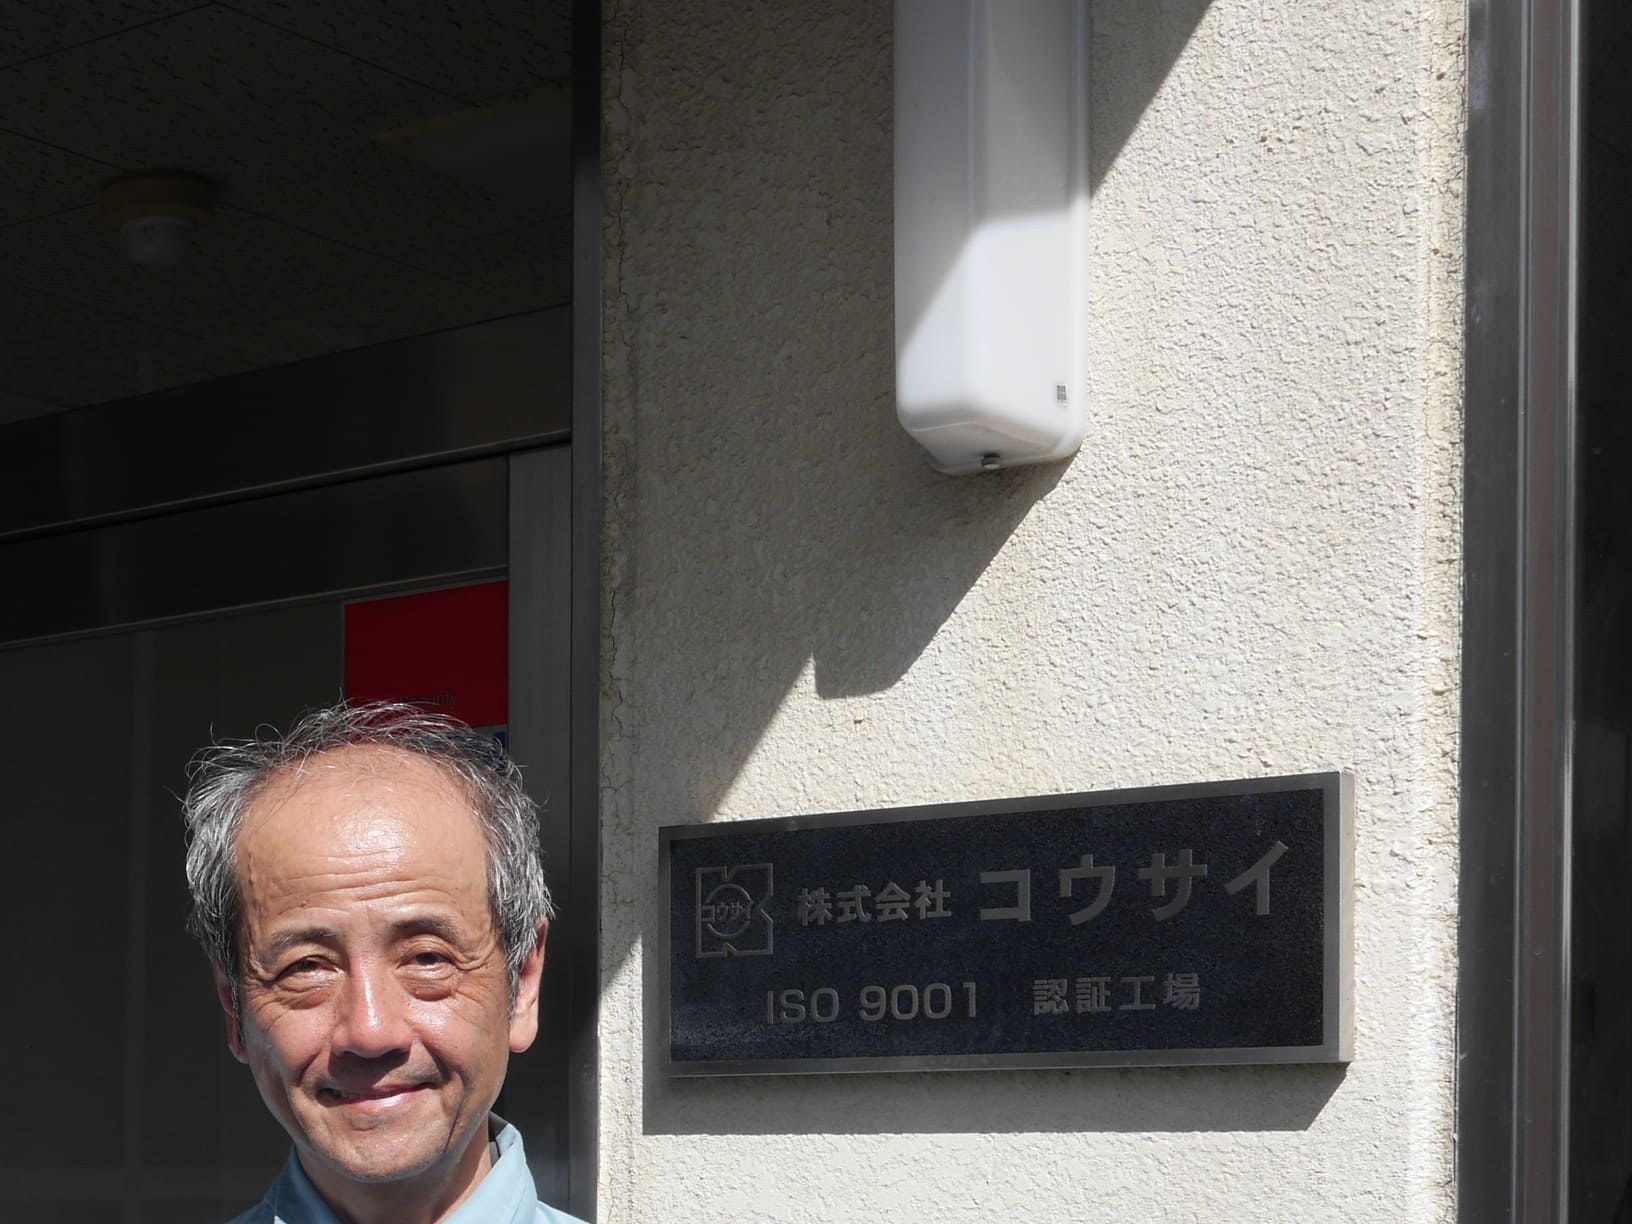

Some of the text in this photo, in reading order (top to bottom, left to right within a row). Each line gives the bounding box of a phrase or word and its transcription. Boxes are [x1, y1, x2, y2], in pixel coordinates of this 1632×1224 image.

[797, 840, 1289, 926] 株式会社 コウサイ
[768, 973, 1201, 1024] ISO 9001 認証工場
